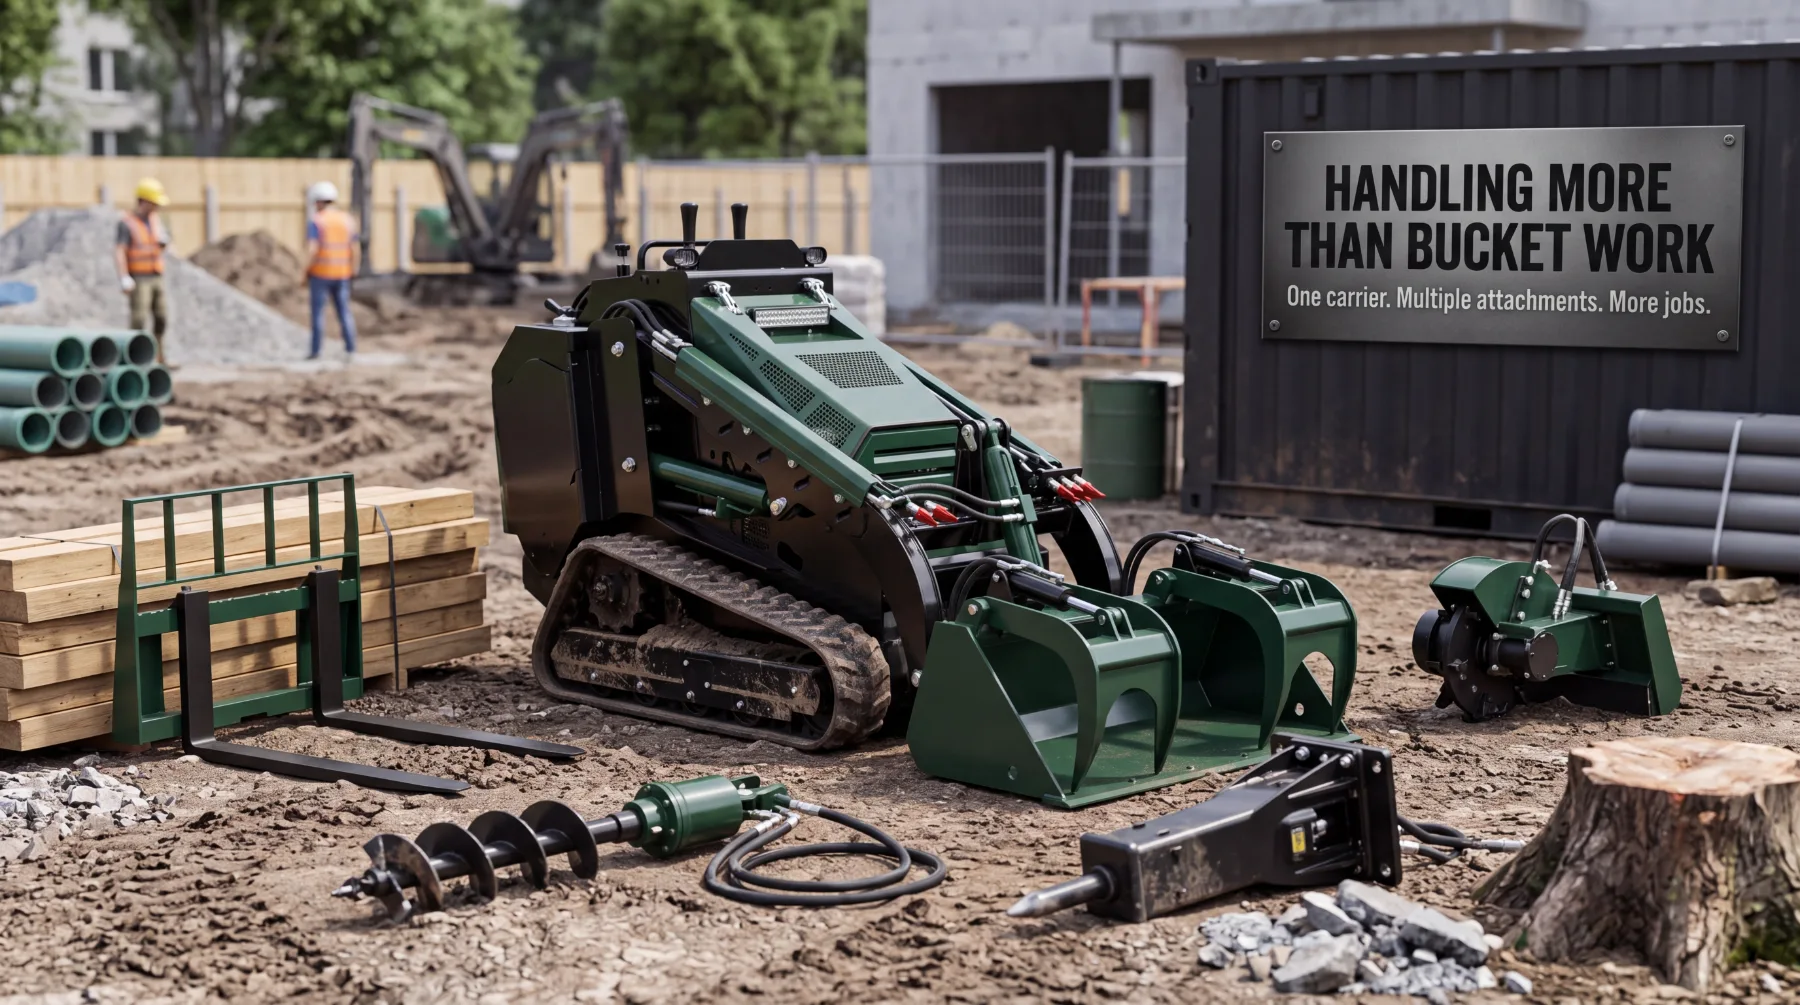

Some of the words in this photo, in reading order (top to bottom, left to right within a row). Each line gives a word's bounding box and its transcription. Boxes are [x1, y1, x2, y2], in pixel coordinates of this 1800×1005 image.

[1325, 164, 1533, 212] HANDLING
[1549, 162, 1672, 212] MORE
[1284, 221, 1393, 270] THAN
[1407, 222, 1572, 272] BUCKET
[1583, 223, 1715, 274] WORK
[1287, 284, 1321, 307] One
[1326, 285, 1391, 308] carrier.
[1396, 286, 1472, 315] Multiple
[1476, 288, 1603, 312] attachments.
[1609, 289, 1659, 314] More
[1662, 290, 1711, 319] jobs.
